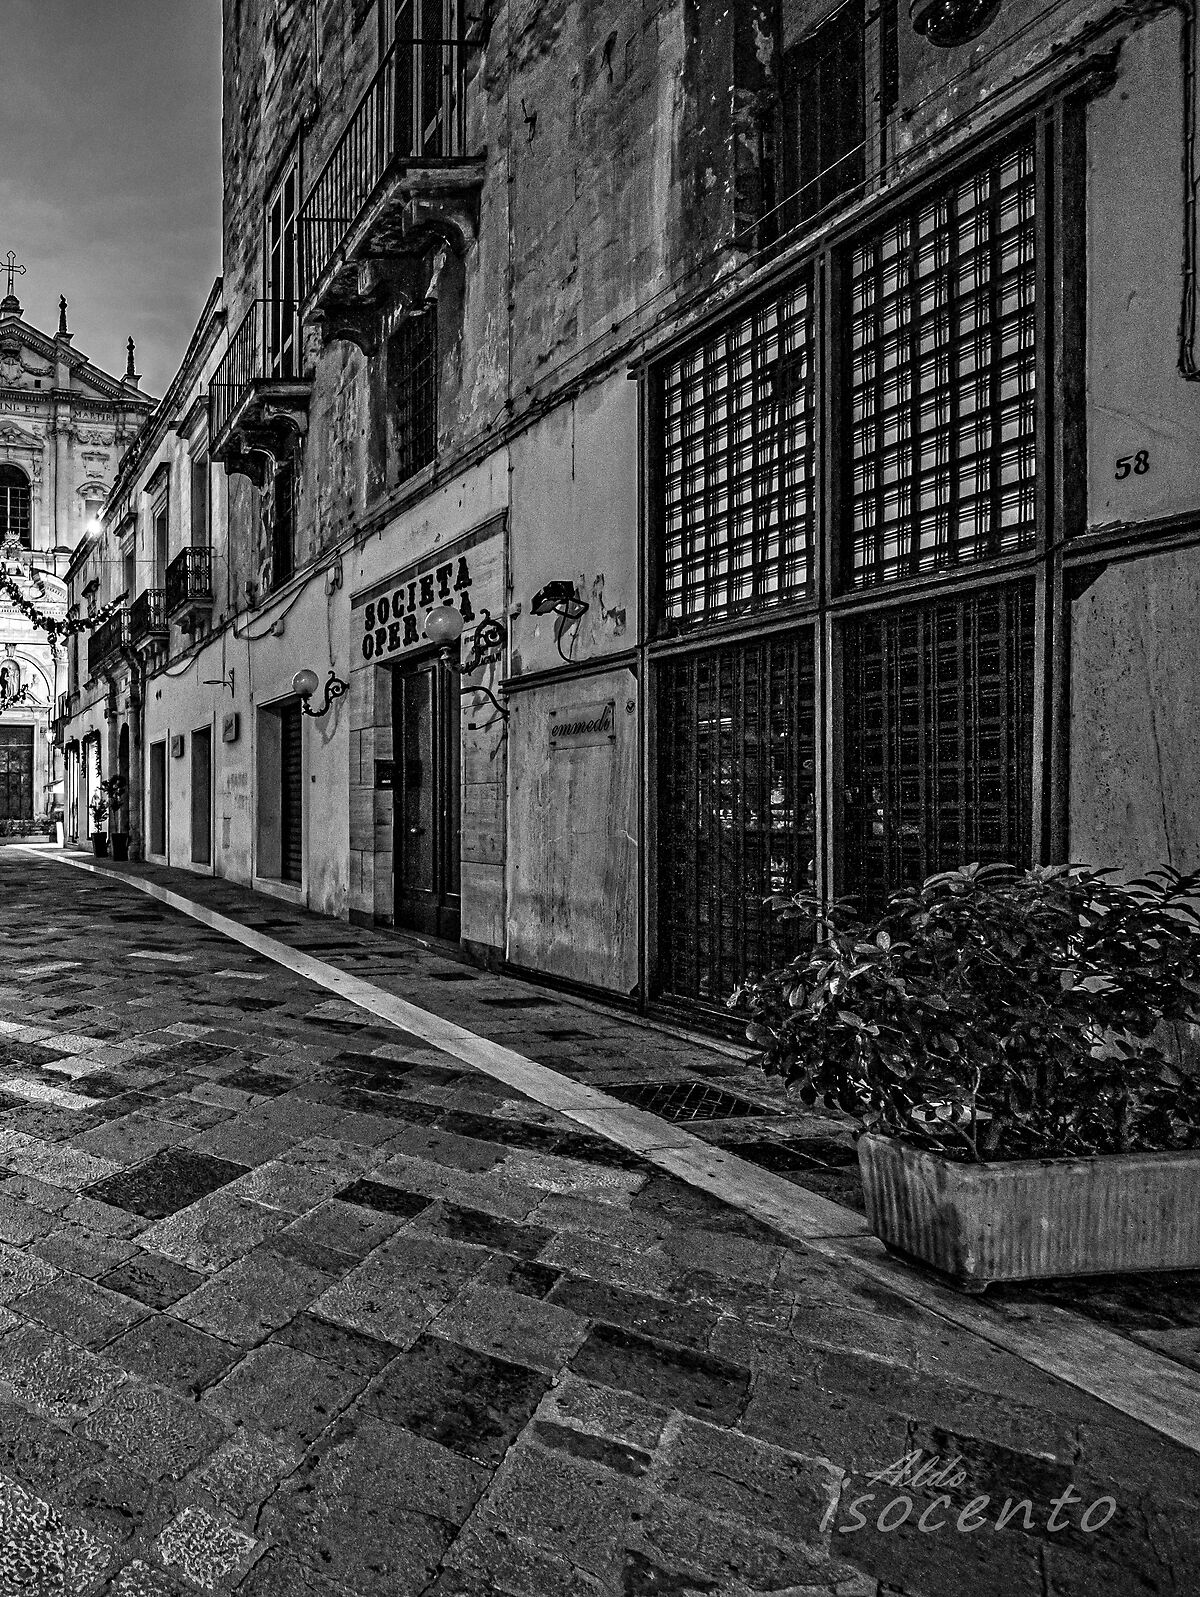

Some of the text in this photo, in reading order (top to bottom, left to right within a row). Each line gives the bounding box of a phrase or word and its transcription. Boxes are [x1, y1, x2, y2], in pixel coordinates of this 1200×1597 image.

[25, 404, 40, 414] ET
[1115, 450, 1150, 480] 58
[365, 556, 472, 631] SOCIETA
[362, 590, 475, 660] OPERA
